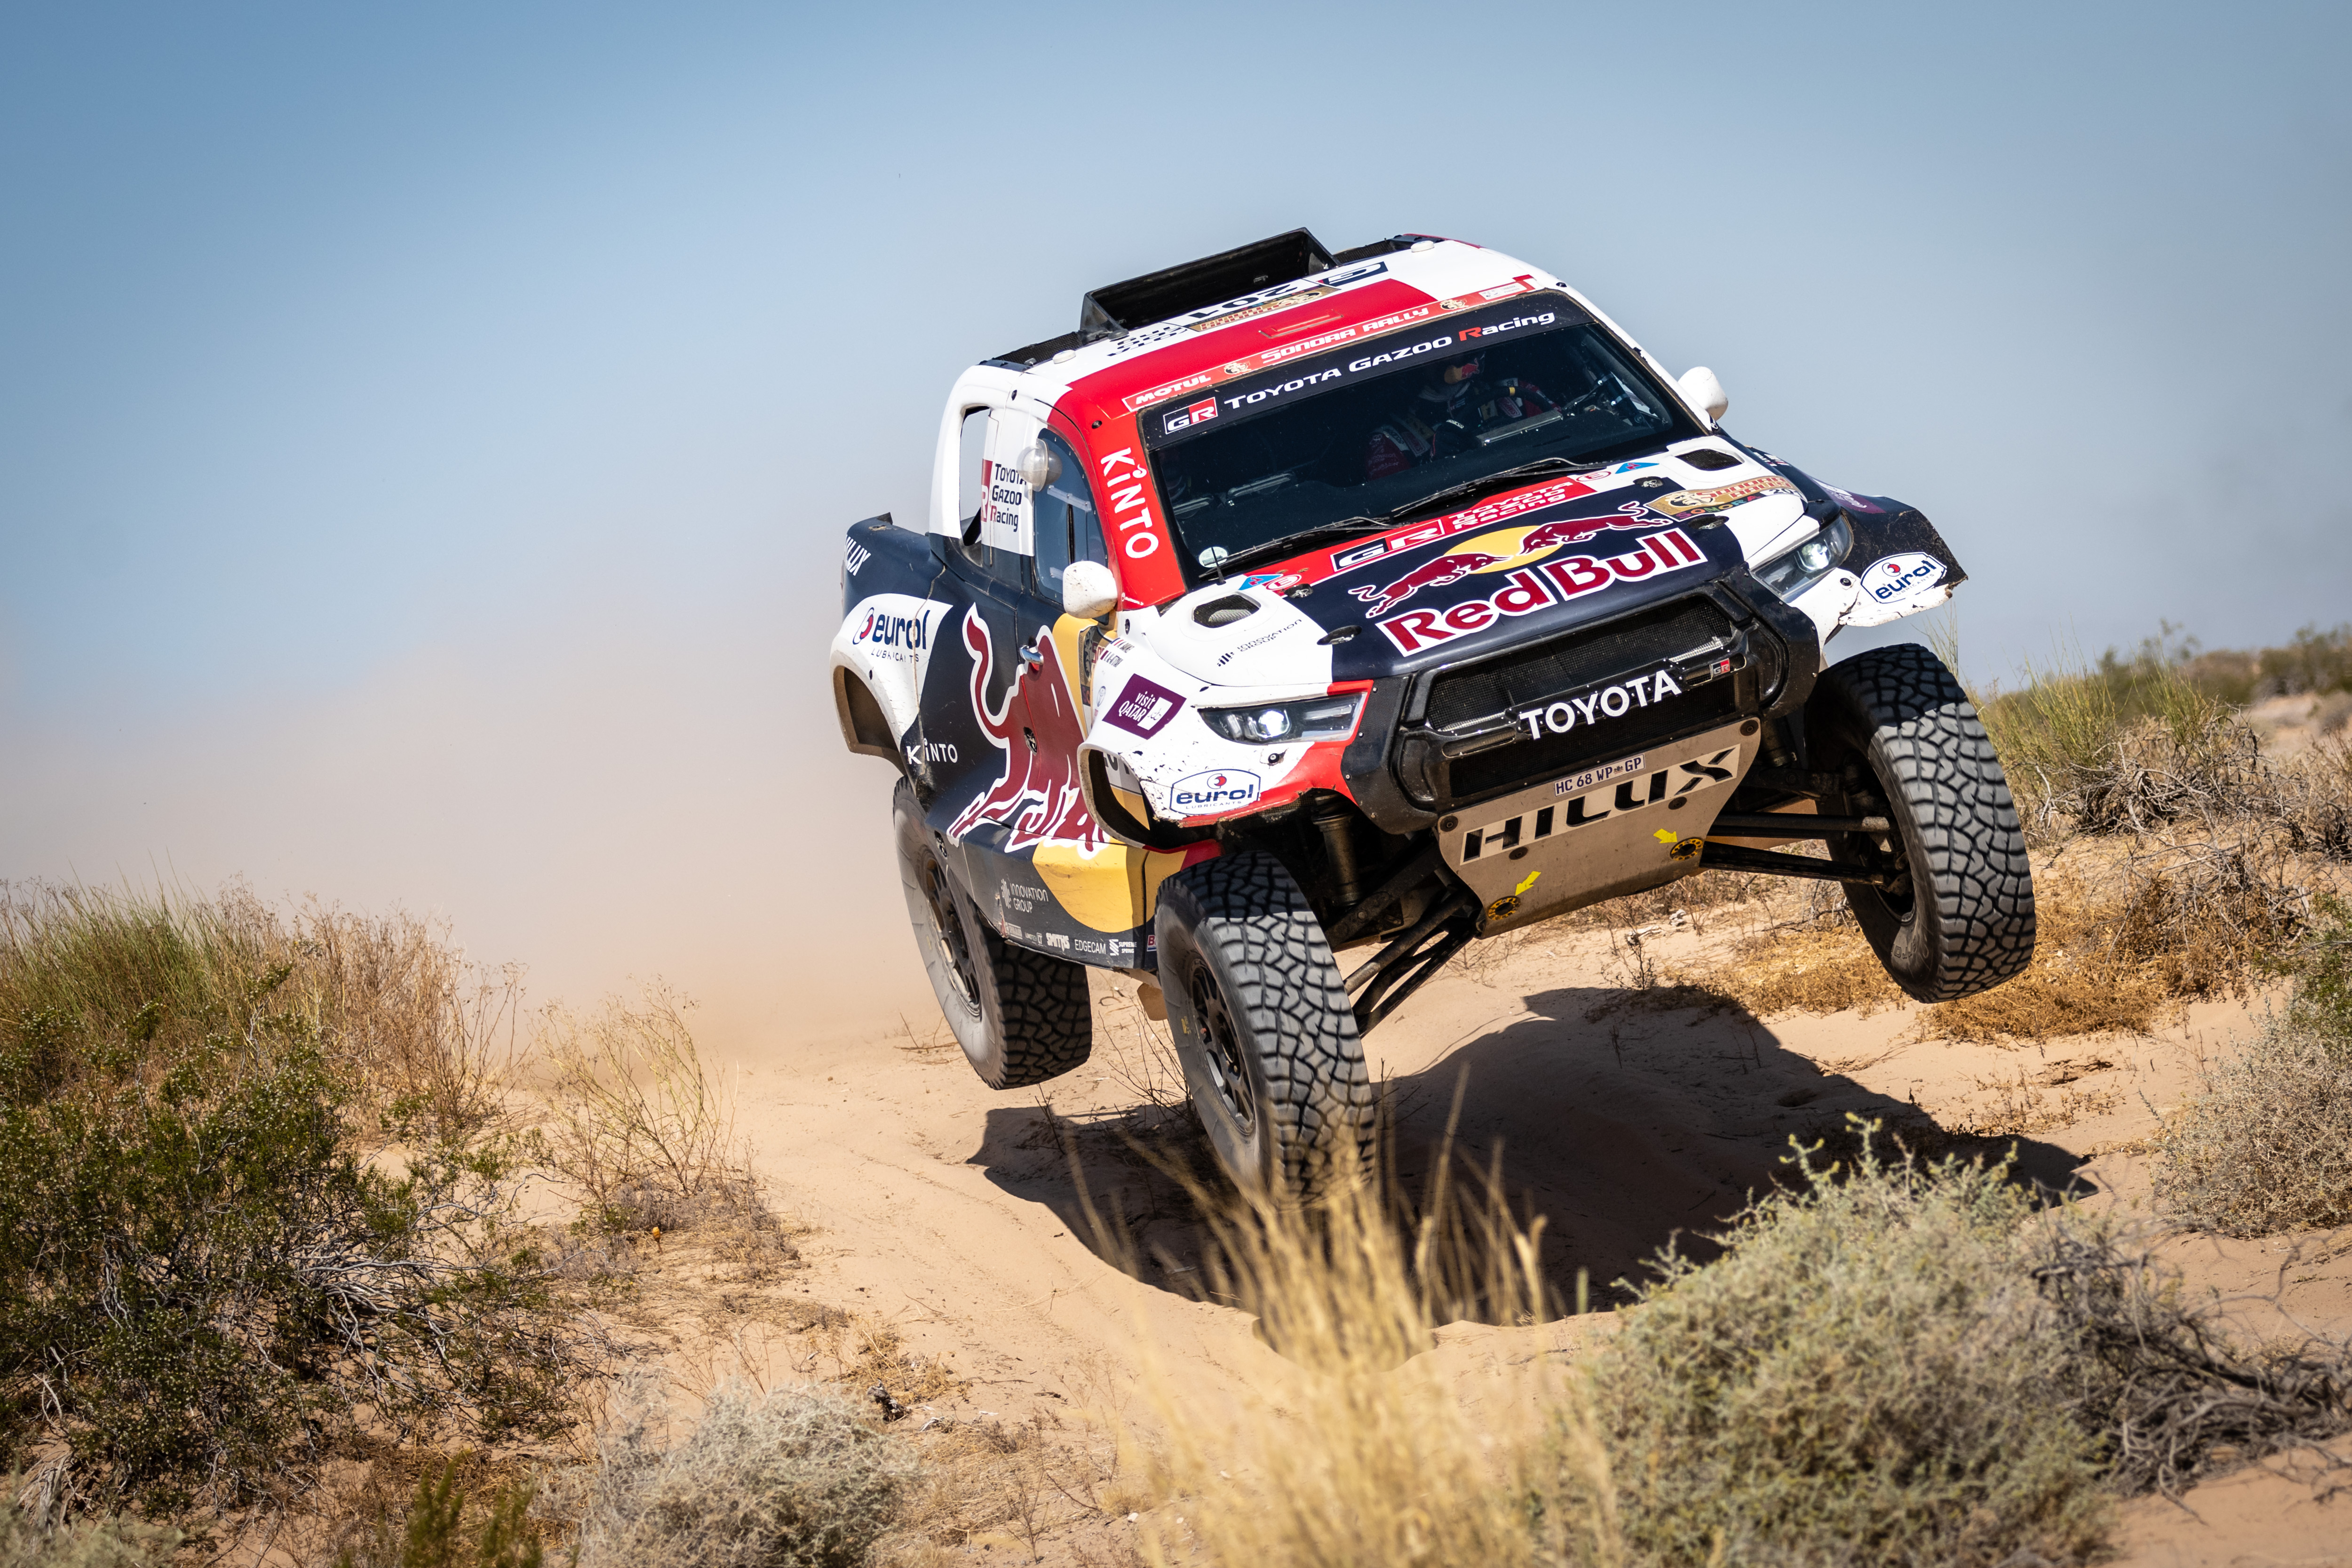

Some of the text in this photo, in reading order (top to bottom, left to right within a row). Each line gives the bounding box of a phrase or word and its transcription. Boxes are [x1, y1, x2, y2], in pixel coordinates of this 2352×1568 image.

[1135, 307, 1429, 405] MOTUL SONORA RALLY
[1167, 312, 1555, 433] GR TOYOTA GAZOO Racing
[992, 485, 1022, 506] GAZOO
[1448, 482, 1573, 519] TOYOTA
[1452, 488, 1565, 525] GAZOO
[1676, 495, 1762, 519] SONORA
[990, 505, 1019, 533] Racing
[1339, 526, 1438, 568] GR
[1375, 527, 1708, 658] Red Bull
[1875, 560, 1937, 599] eurol
[1892, 573, 1935, 598] LUBRICANTS
[872, 609, 931, 650] eurol
[1240, 636, 1276, 652] GROUP
[1713, 662, 1731, 676] GR
[1118, 700, 1147, 722] QATAR
[1135, 691, 1156, 709] visit
[1519, 669, 1682, 740] TOYOTA
[1555, 757, 1642, 794] HC 68 WP GP
[1176, 784, 1254, 804] eurol
[1185, 801, 1242, 810] LUBRICANTS
[1463, 746, 1737, 864] HILUX
[1013, 898, 1033, 914] GROUP
[1074, 939, 1106, 955] EDGECAM
